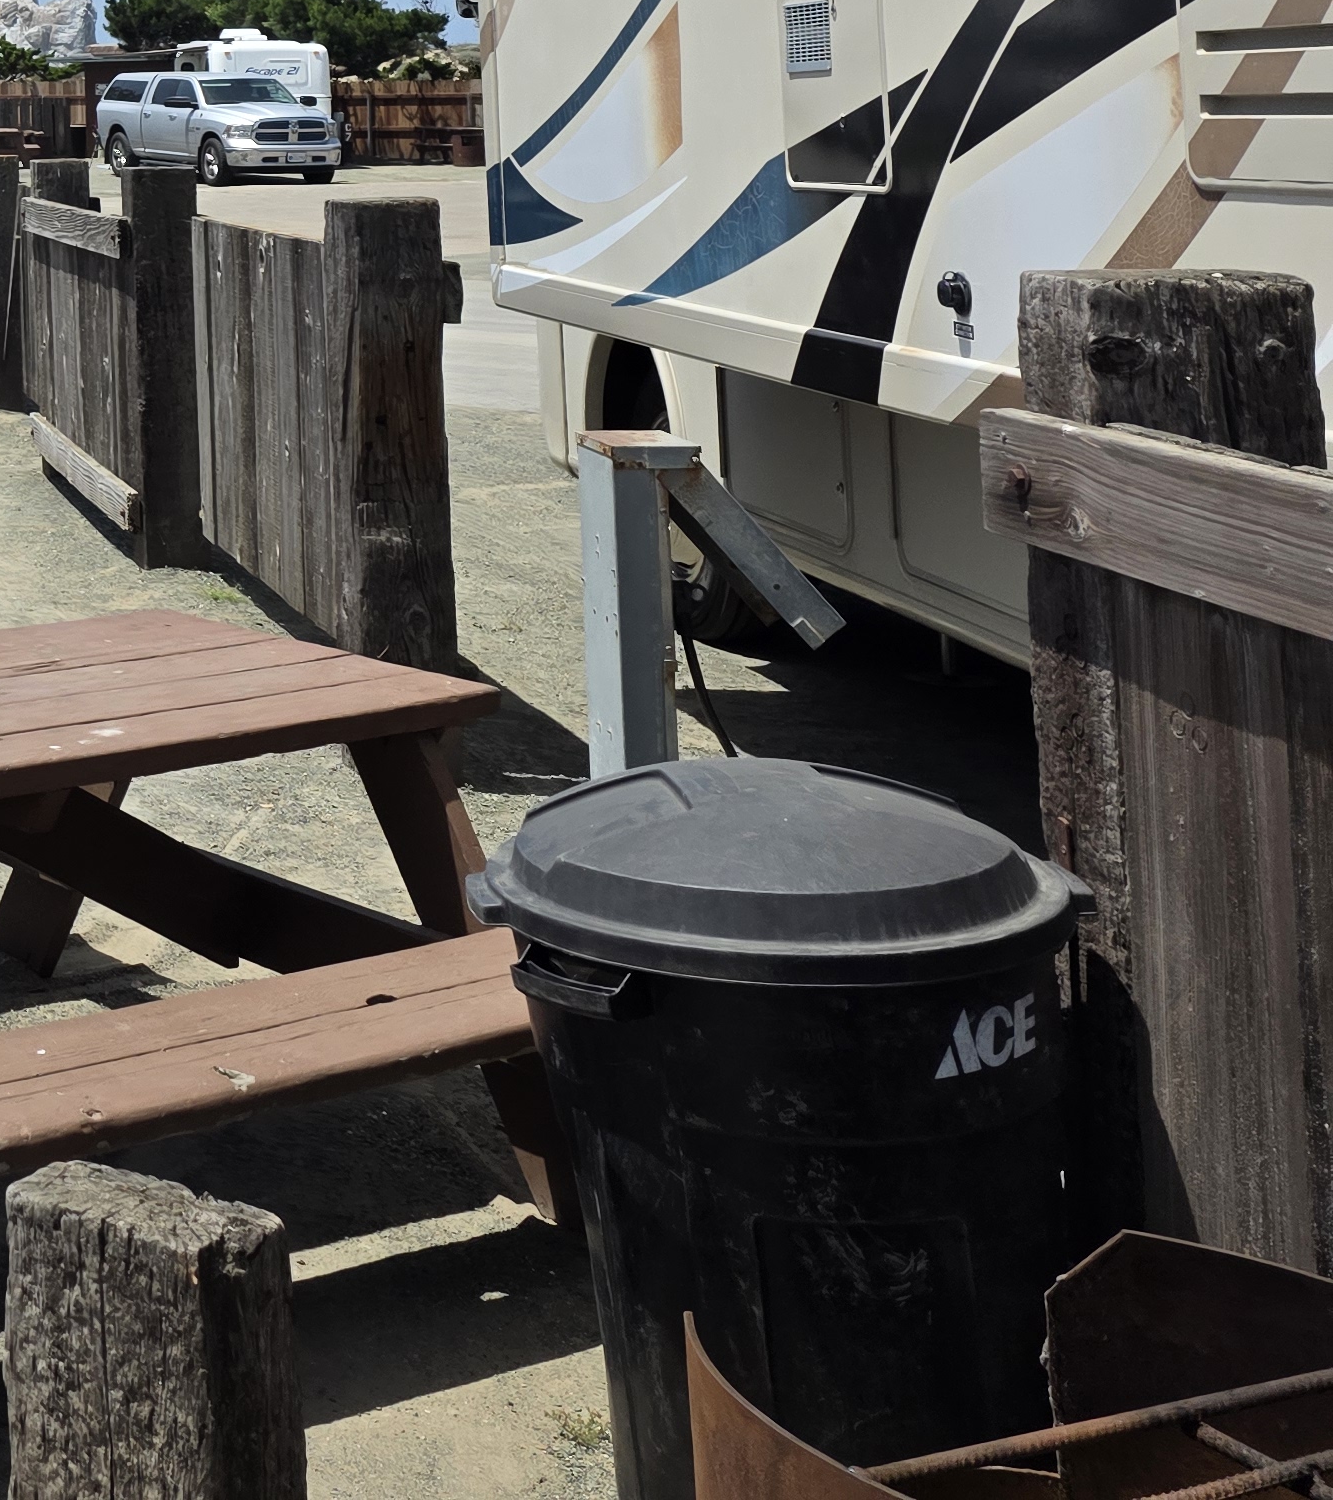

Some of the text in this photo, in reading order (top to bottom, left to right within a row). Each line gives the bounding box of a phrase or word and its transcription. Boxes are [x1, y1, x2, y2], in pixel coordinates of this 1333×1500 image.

[245, 66, 300, 77] Escape 21
[934, 991, 1036, 1080] ACE
